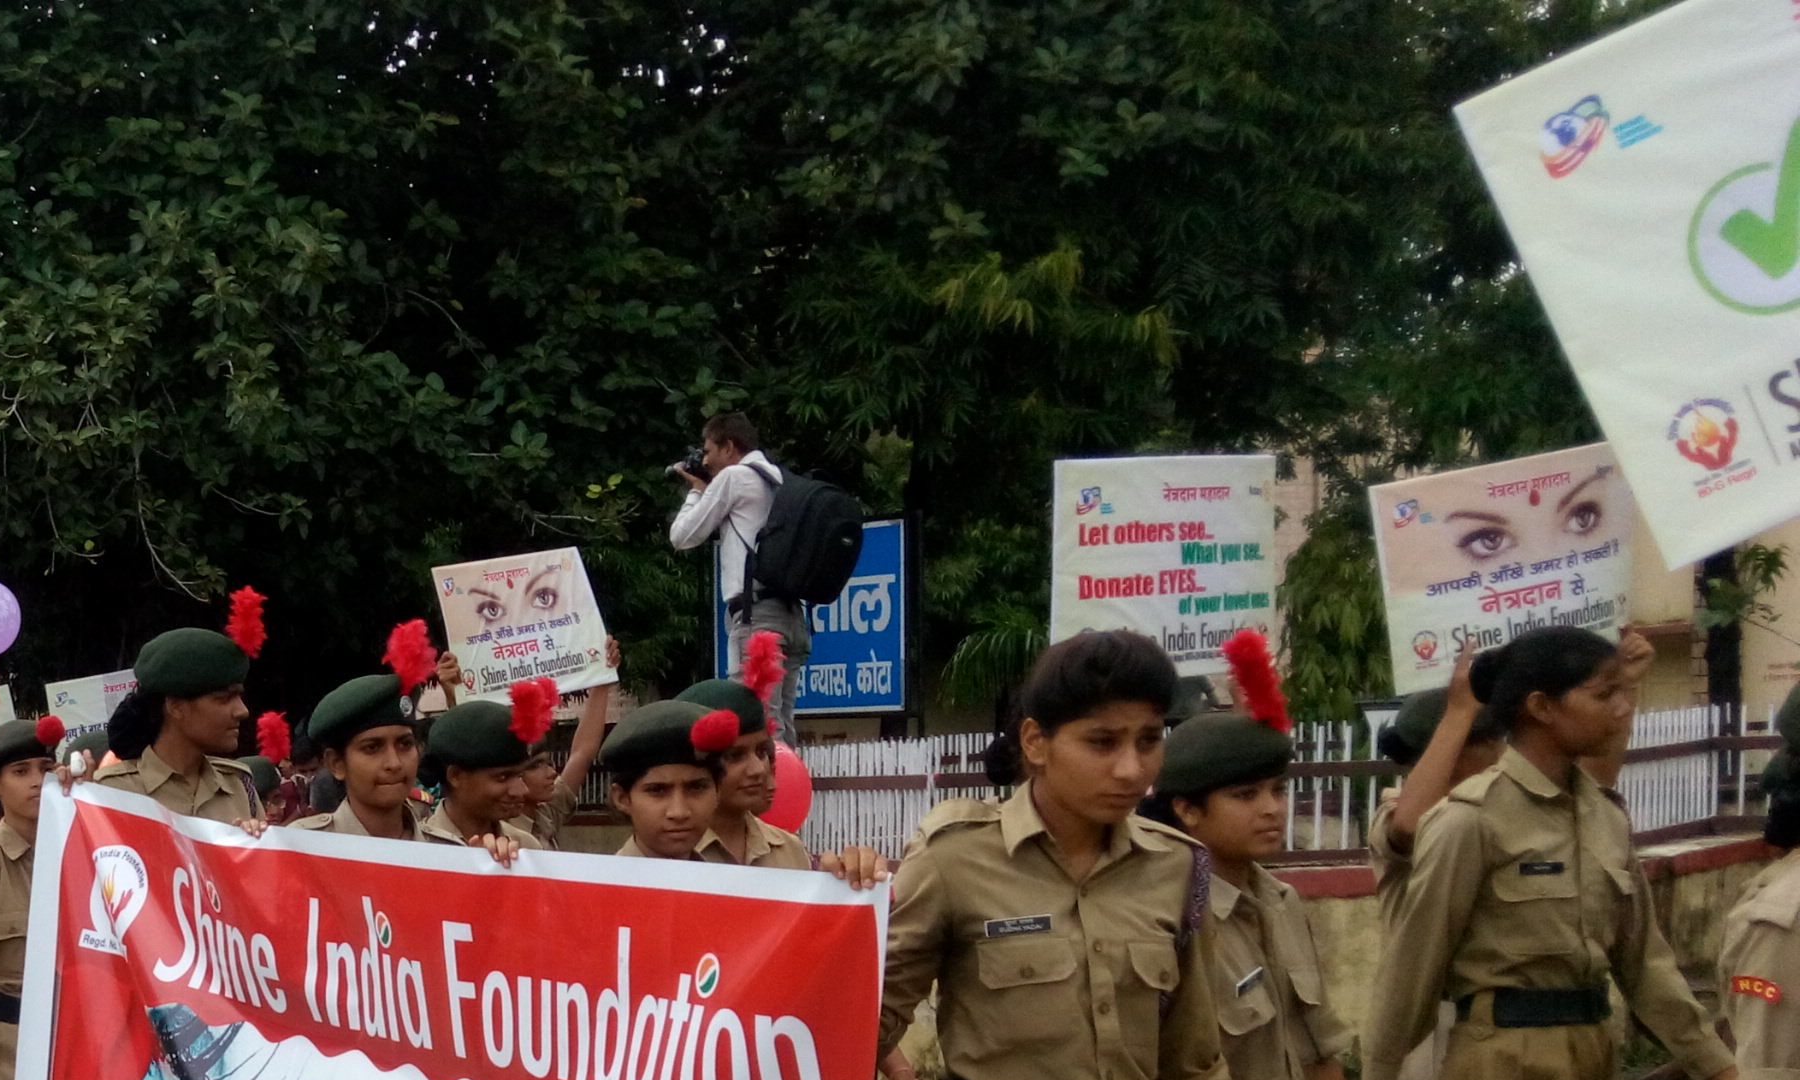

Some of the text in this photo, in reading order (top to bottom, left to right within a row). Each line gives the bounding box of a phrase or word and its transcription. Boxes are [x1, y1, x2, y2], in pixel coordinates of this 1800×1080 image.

[1162, 482, 1231, 502] नेत्रदान महादान
[1487, 471, 1571, 499] नेत्रदान महादान
[1078, 522, 1110, 547] Let
[1113, 520, 1176, 544] others
[1181, 542, 1218, 565] What
[1220, 542, 1241, 565] you
[482, 570, 505, 583] नेत्रदान
[1078, 573, 1154, 600] Donate
[1426, 571, 1483, 597] आपकी
[1530, 558, 1563, 576] अमर
[1566, 551, 1579, 568] हो
[1178, 597, 1191, 615] of
[1194, 595, 1220, 616] your
[1479, 580, 1562, 614] नेत्रदान
[466, 630, 494, 646] आपकी
[516, 625, 537, 637] अमर
[538, 618, 547, 633] हो
[549, 614, 573, 629] सकती
[1163, 622, 1196, 652] India
[491, 638, 540, 661] नेत्रदान
[480, 665, 508, 686] Shine
[508, 659, 533, 676] India
[535, 651, 585, 672] Foundation
[856, 648, 892, 695] कोटा
[103, 681, 127, 695] नेत्रदान
[153, 865, 287, 1015] Shine
[304, 895, 432, 1050] India
[1738, 979, 1776, 998] NCC
